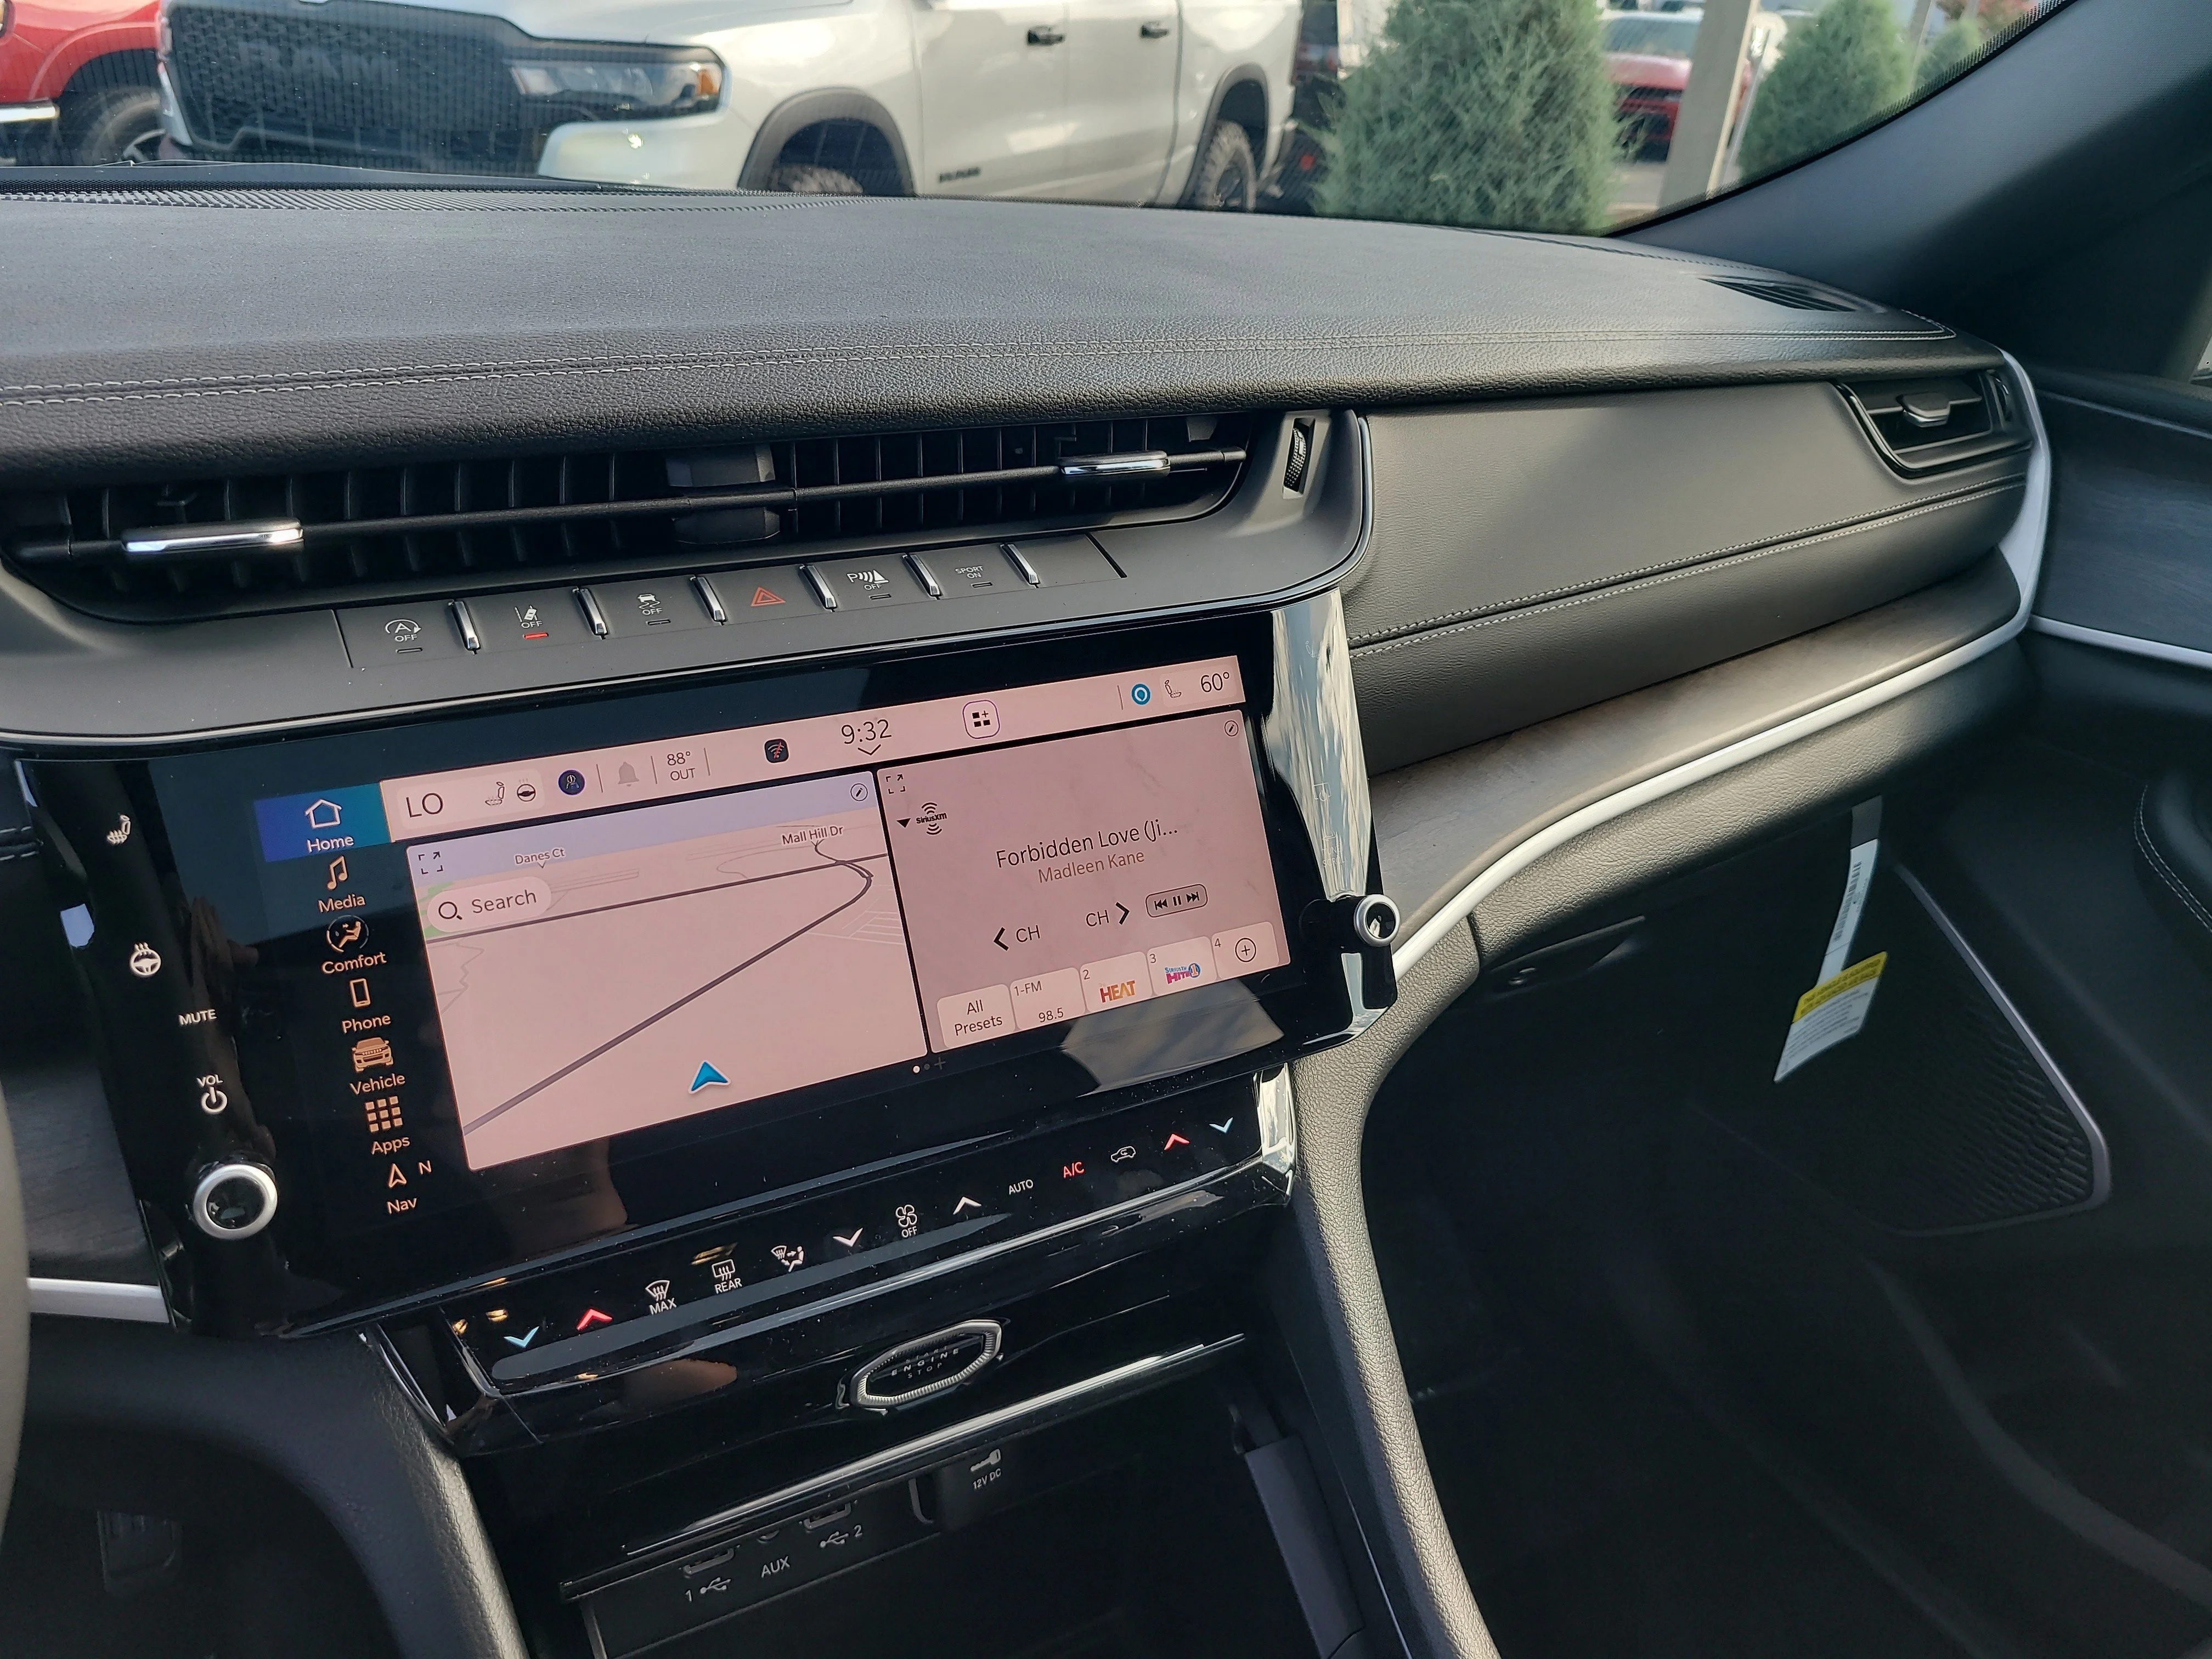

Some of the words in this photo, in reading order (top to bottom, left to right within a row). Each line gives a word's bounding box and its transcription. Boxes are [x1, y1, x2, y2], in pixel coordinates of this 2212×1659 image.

[955, 566, 983, 574] SPORT
[642, 607, 663, 616] OFF
[521, 619, 543, 629] OFF
[395, 633, 418, 642] OFF
[1200, 672, 1230, 693] 60°
[841, 719, 891, 745] 9:32
[667, 751, 691, 766] 88°
[670, 768, 695, 781] OUT
[407, 792, 444, 819] LO
[307, 834, 354, 853] Home
[782, 832, 807, 845] Mall
[809, 828, 828, 840] Hill
[830, 825, 844, 837] Dr
[996, 837, 1094, 868] Forbidden
[1098, 827, 1140, 848] Love
[515, 852, 549, 865] Danes
[552, 848, 565, 859] Ct
[1038, 860, 1104, 883] Madleen
[1108, 851, 1144, 869] Kane
[318, 894, 366, 913] Media
[471, 889, 537, 914] Search
[1086, 910, 1109, 928] CH
[1016, 925, 1041, 943] CH
[1215, 938, 1221, 948] 4
[322, 951, 387, 974] Comfort
[1149, 953, 1156, 963] 3
[1083, 969, 1091, 980] 2
[1014, 980, 1042, 996] 1-FM
[1100, 980, 1135, 1003] HEAT
[967, 999, 984, 1015] All
[1039, 1007, 1064, 1023] 98.5
[178, 1009, 216, 1026] MUTE
[342, 1013, 391, 1034] Phone
[955, 1015, 1003, 1036] Presets
[196, 1074, 223, 1087] VOL
[350, 1073, 406, 1095] Vehicle
[371, 1136, 410, 1155] Apps
[418, 1161, 432, 1175] N
[1062, 1161, 1085, 1180] A/C
[1008, 1178, 1034, 1195] AUTO
[386, 1197, 417, 1214] Nav
[901, 1226, 917, 1238] OFF
[714, 1278, 743, 1294] REAR
[649, 1297, 677, 1315] MAX
[891, 1347, 959, 1376] ENGINE
[906, 1346, 947, 1364] START
[907, 1362, 943, 1379] STOP
[972, 1475, 988, 1491] 12V
[989, 1468, 1002, 1481] DC
[854, 1525, 864, 1538] 2
[761, 1556, 792, 1578] AUX
[685, 1589, 693, 1602] 1
